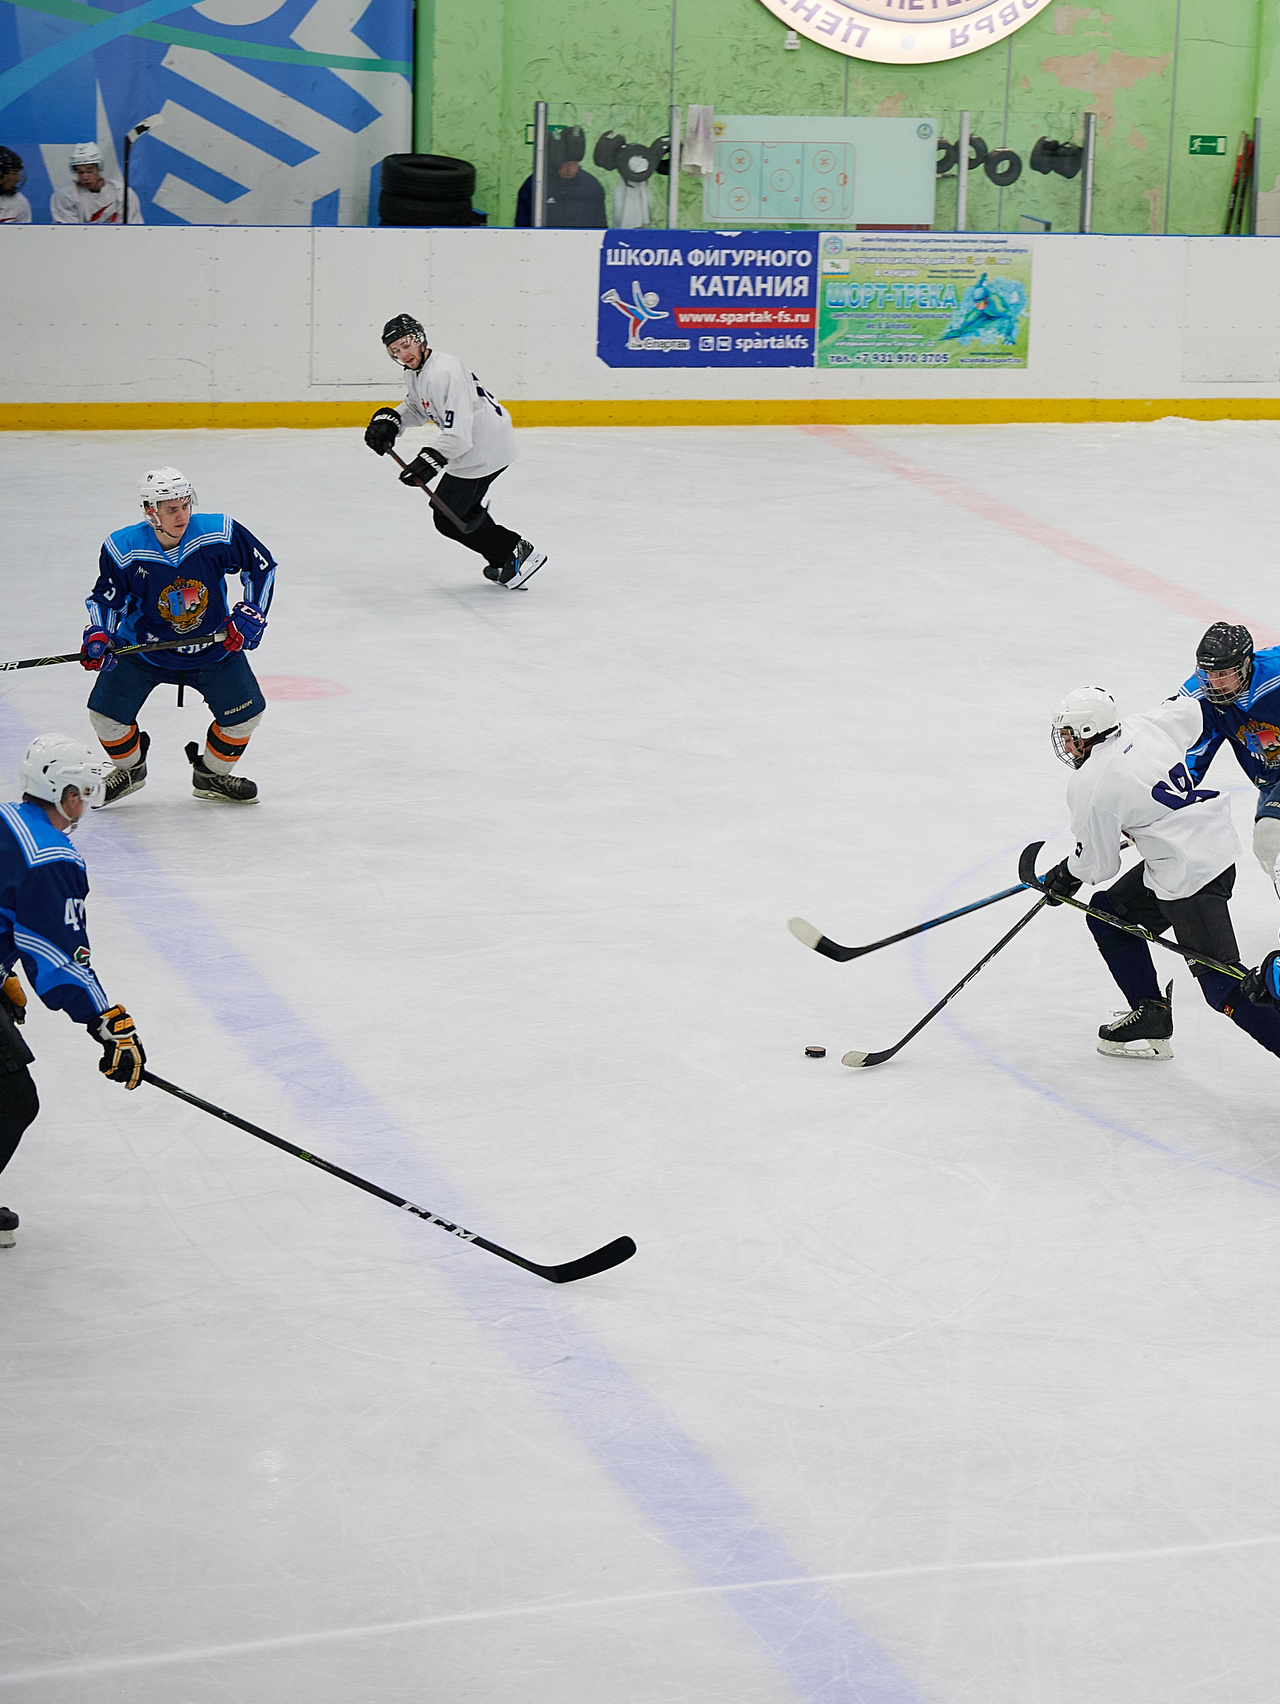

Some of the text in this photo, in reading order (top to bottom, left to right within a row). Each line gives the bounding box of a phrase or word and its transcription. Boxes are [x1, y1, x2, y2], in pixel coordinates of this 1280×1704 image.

[778, 0, 870, 49] ЦЕН
[606, 248, 813, 267] ШКОЛА ФИГУРНОГО
[689, 275, 810, 297] КАТАНИЯ
[826, 282, 958, 309] ШОРТ-ТРЕКА
[678, 311, 810, 325] www.spartak-fs.ru
[735, 335, 809, 352] spartakfs
[872, 353, 893, 363] 931
[898, 353, 918, 363] 970
[921, 353, 950, 364] 3705
[224, 699, 254, 716] BAUER
[401, 1201, 479, 1243] CCM
